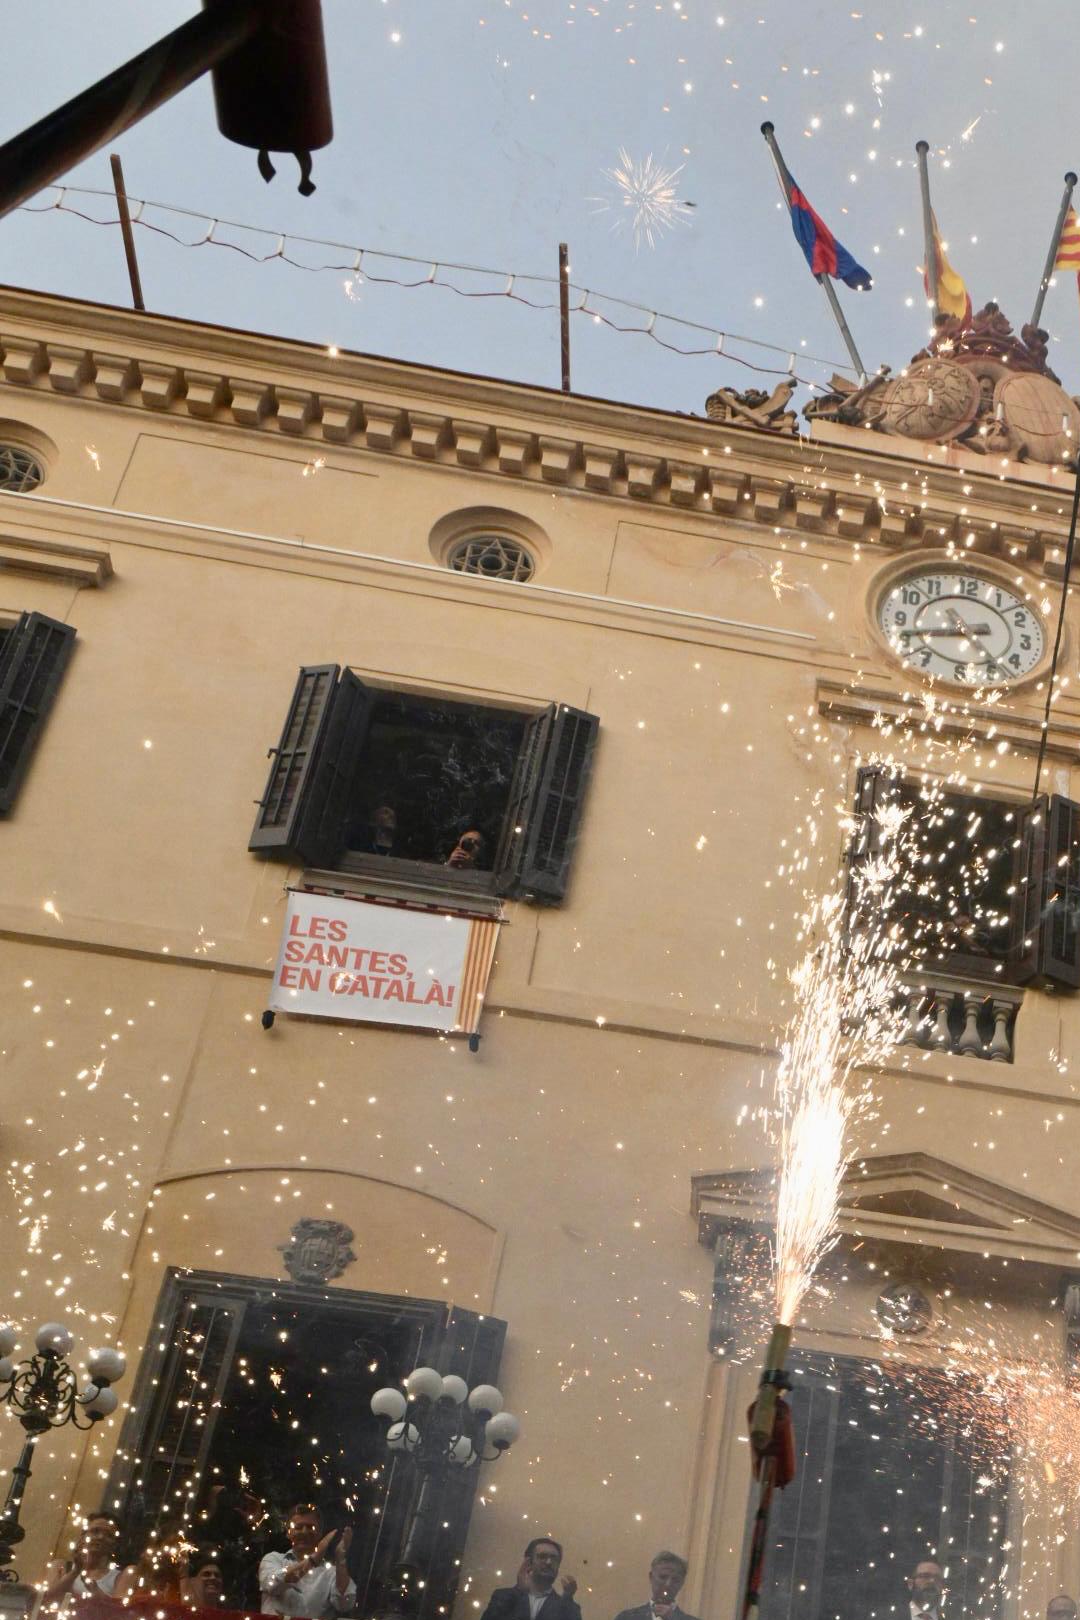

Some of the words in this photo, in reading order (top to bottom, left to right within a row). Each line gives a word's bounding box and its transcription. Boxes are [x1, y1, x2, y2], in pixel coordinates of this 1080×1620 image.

[927, 579, 941, 596] 11
[960, 579, 978, 597] 12
[902, 589, 921, 606] 10
[995, 593, 1002, 607] 1
[894, 611, 907, 627] 9
[1014, 611, 1026, 628] 2
[1020, 634, 1032, 651] 3
[920, 651, 932, 667] 7
[1008, 654, 1022, 669] 4
[289, 915, 348, 942] LES
[284, 941, 414, 980] SANTES,
[279, 965, 322, 992] EN
[328, 970, 456, 1008] CATALÀ!
